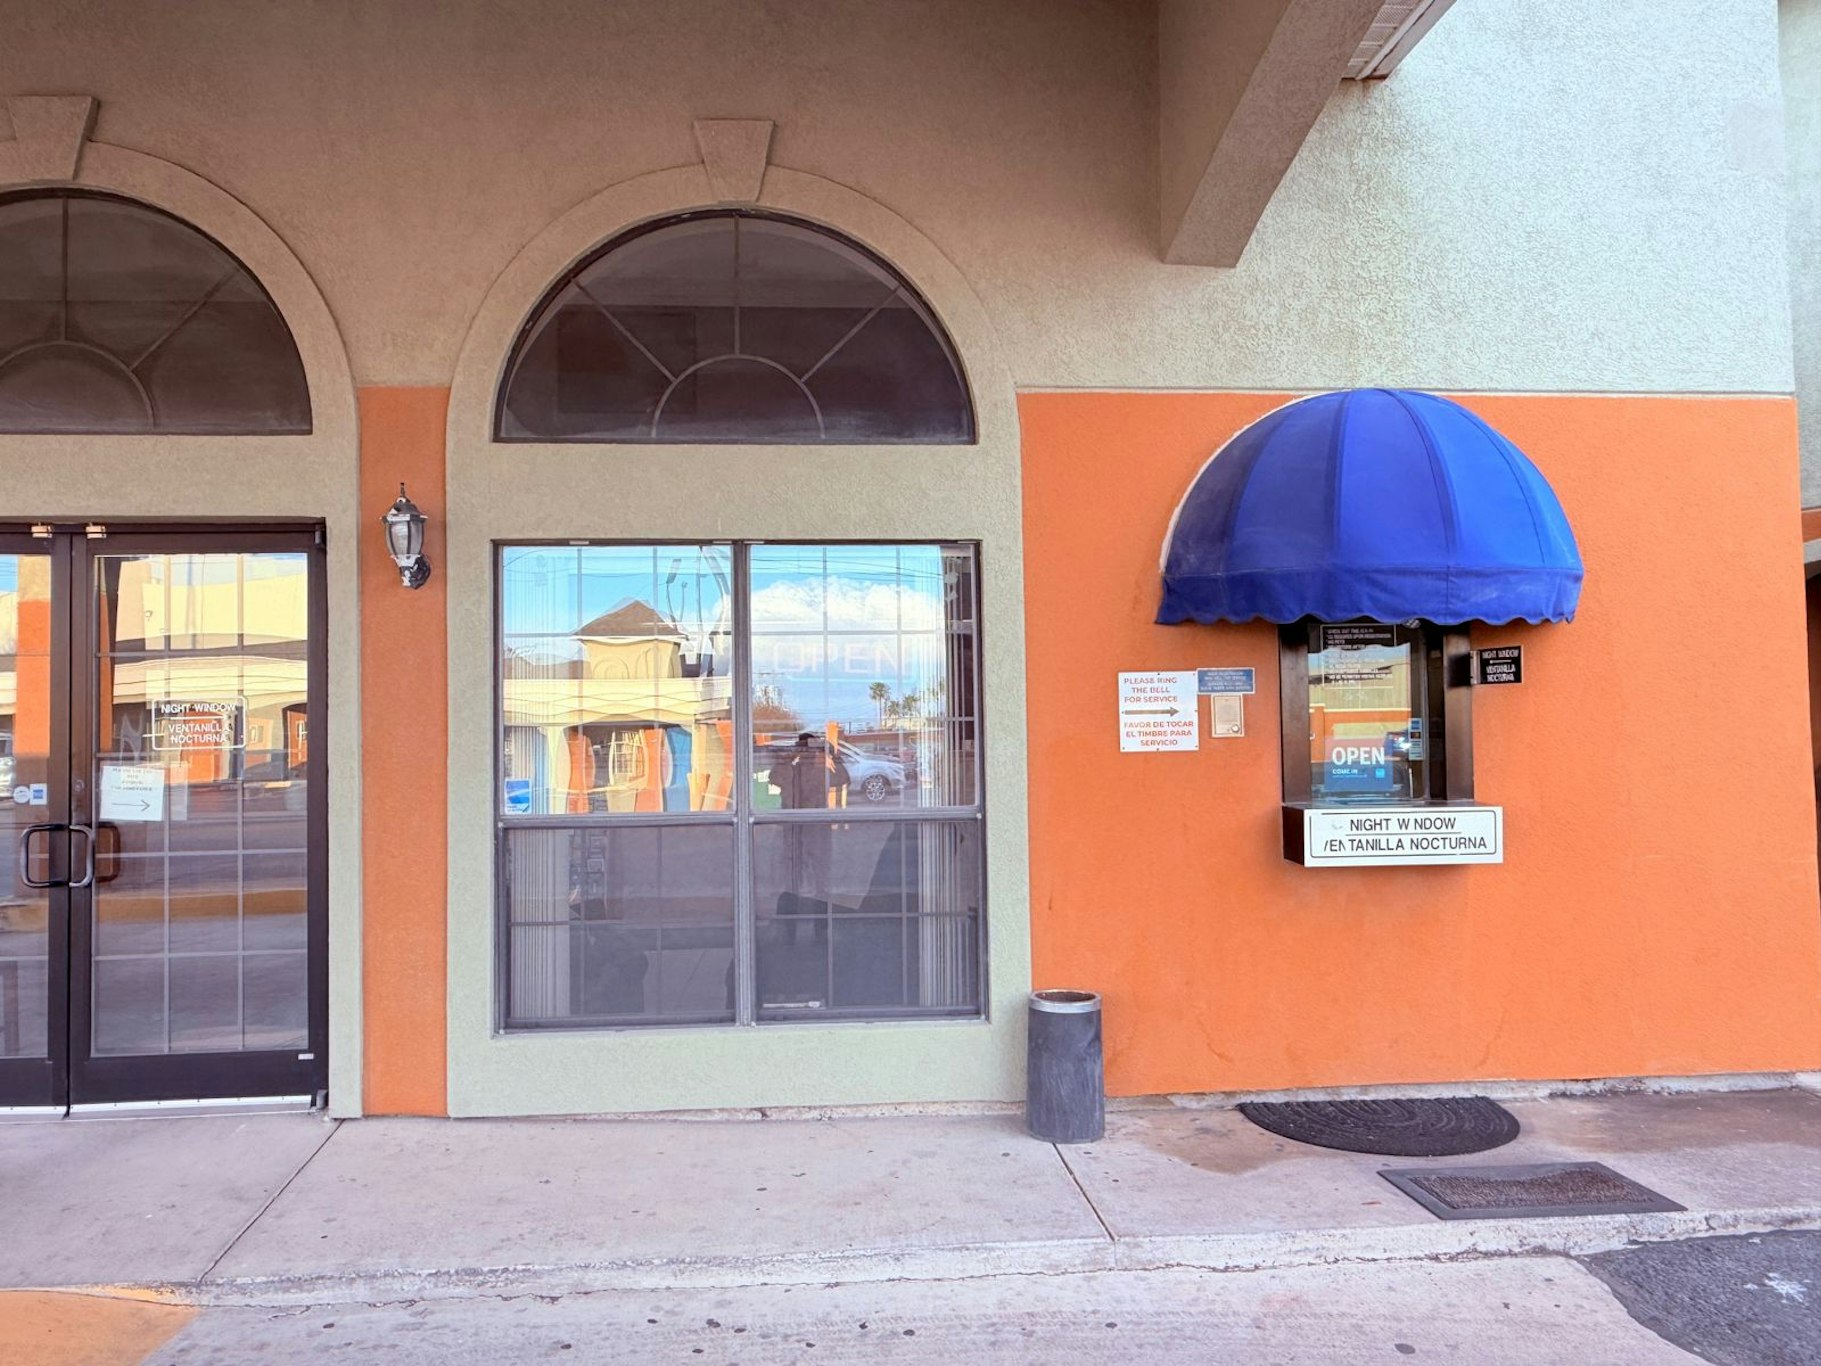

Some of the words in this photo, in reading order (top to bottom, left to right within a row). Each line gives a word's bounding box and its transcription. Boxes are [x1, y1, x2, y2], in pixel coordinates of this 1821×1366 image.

[774, 641, 912, 676] OPEN
[1157, 676, 1178, 684] RING
[1143, 695, 1178, 703] SERVICE
[161, 703, 190, 713] NIGHT
[194, 702, 236, 712] WINDOW
[1124, 721, 1152, 729] FAVOR
[170, 733, 227, 743] NOCTURNA
[1138, 730, 1168, 738] TIMBRE
[1170, 729, 1193, 737] PARA
[1140, 739, 1178, 747] SERVICIO
[1332, 746, 1385, 766] OPEN
[1350, 818, 1391, 832] NIGHT
[1410, 836, 1487, 851] NOCTURNA
